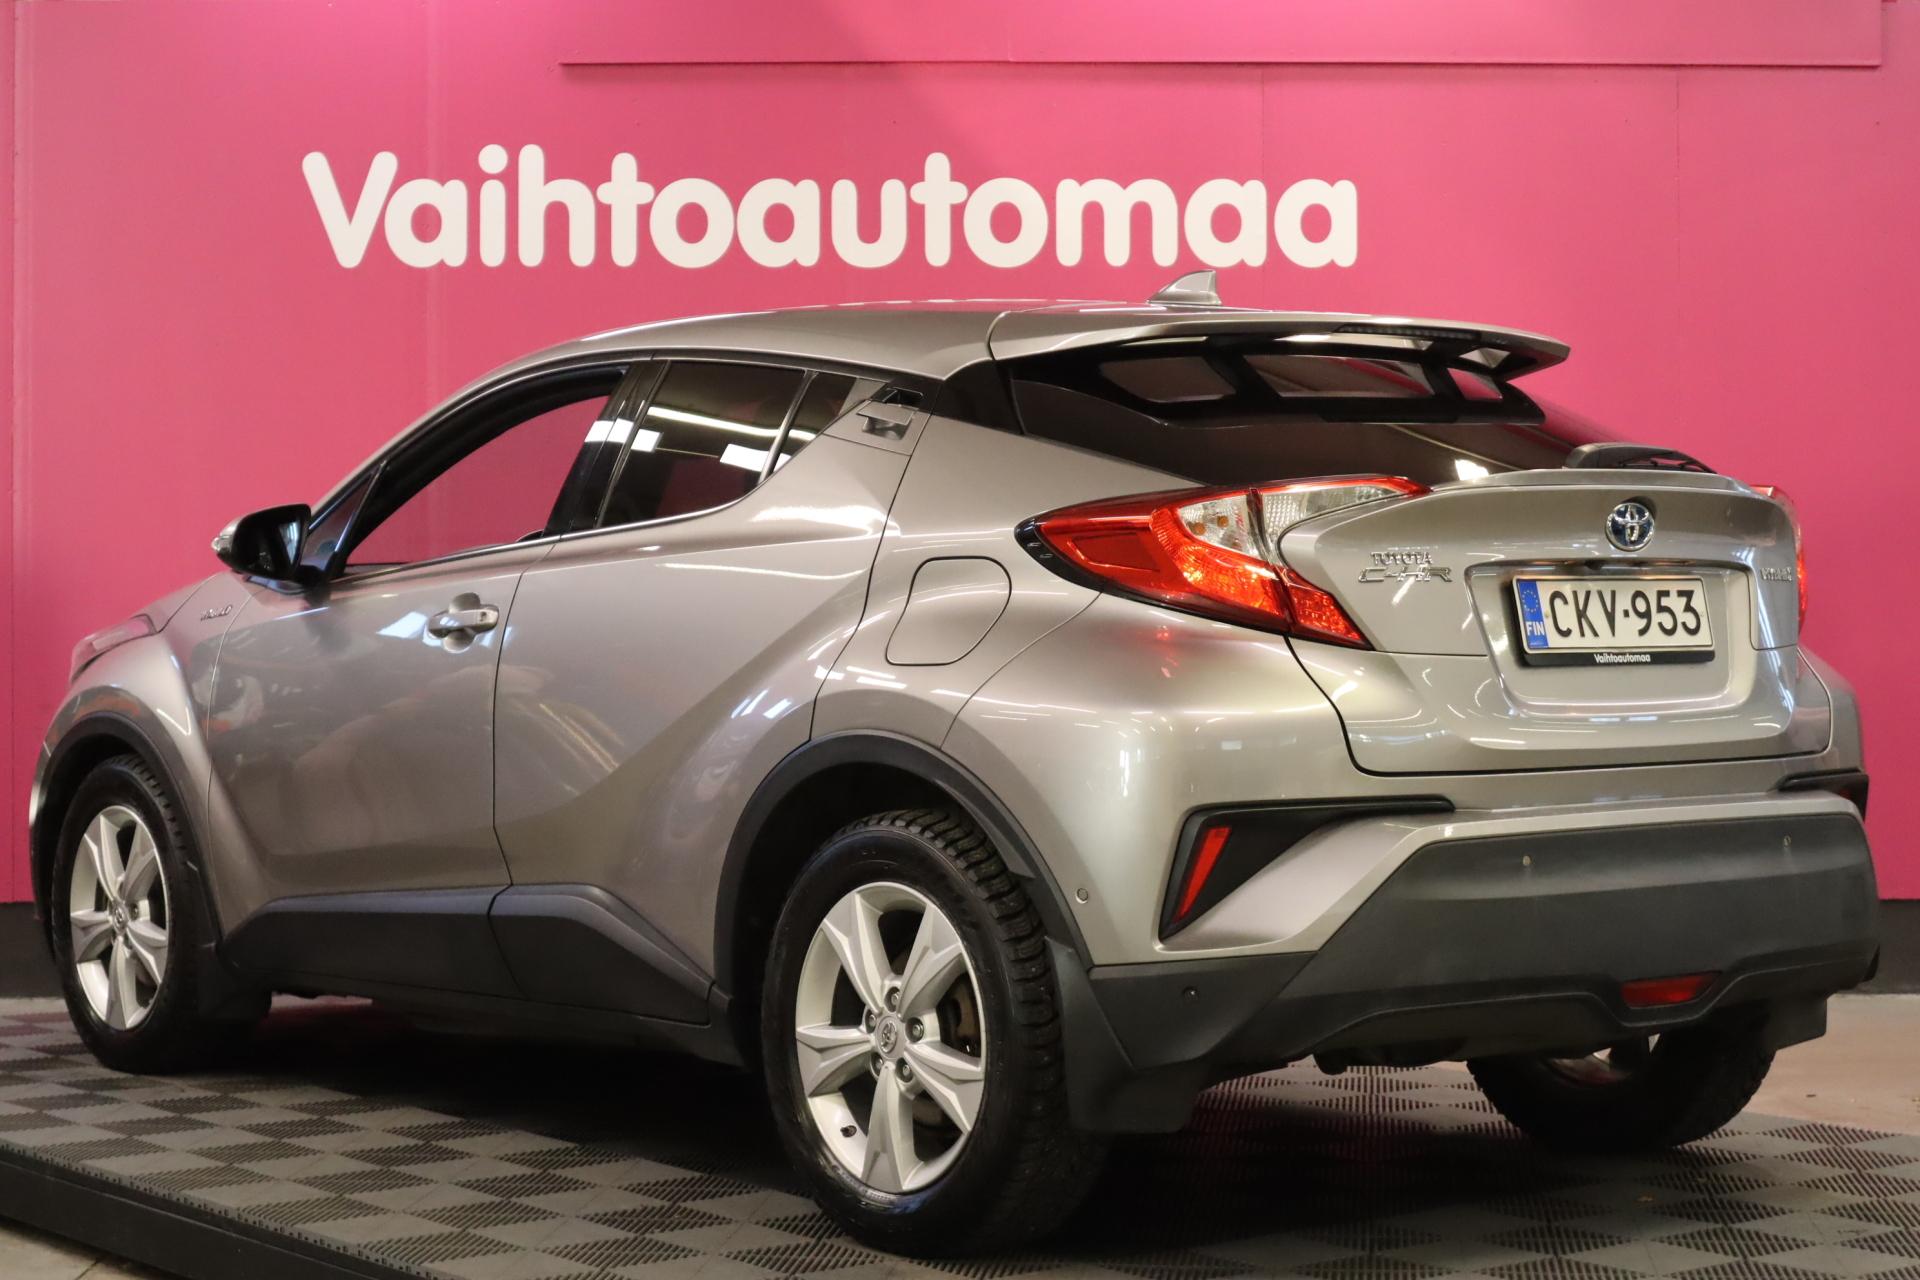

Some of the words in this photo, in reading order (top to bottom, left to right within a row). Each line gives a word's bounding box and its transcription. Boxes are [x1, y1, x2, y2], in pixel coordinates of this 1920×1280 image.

[302, 143, 1358, 269] Vaihtoautomaa
[1371, 551, 1433, 565] TOYOTA
[1358, 564, 1453, 582] C-HR
[1526, 621, 1545, 636] FIN
[1593, 652, 1651, 664] Vaihtoautomaa
